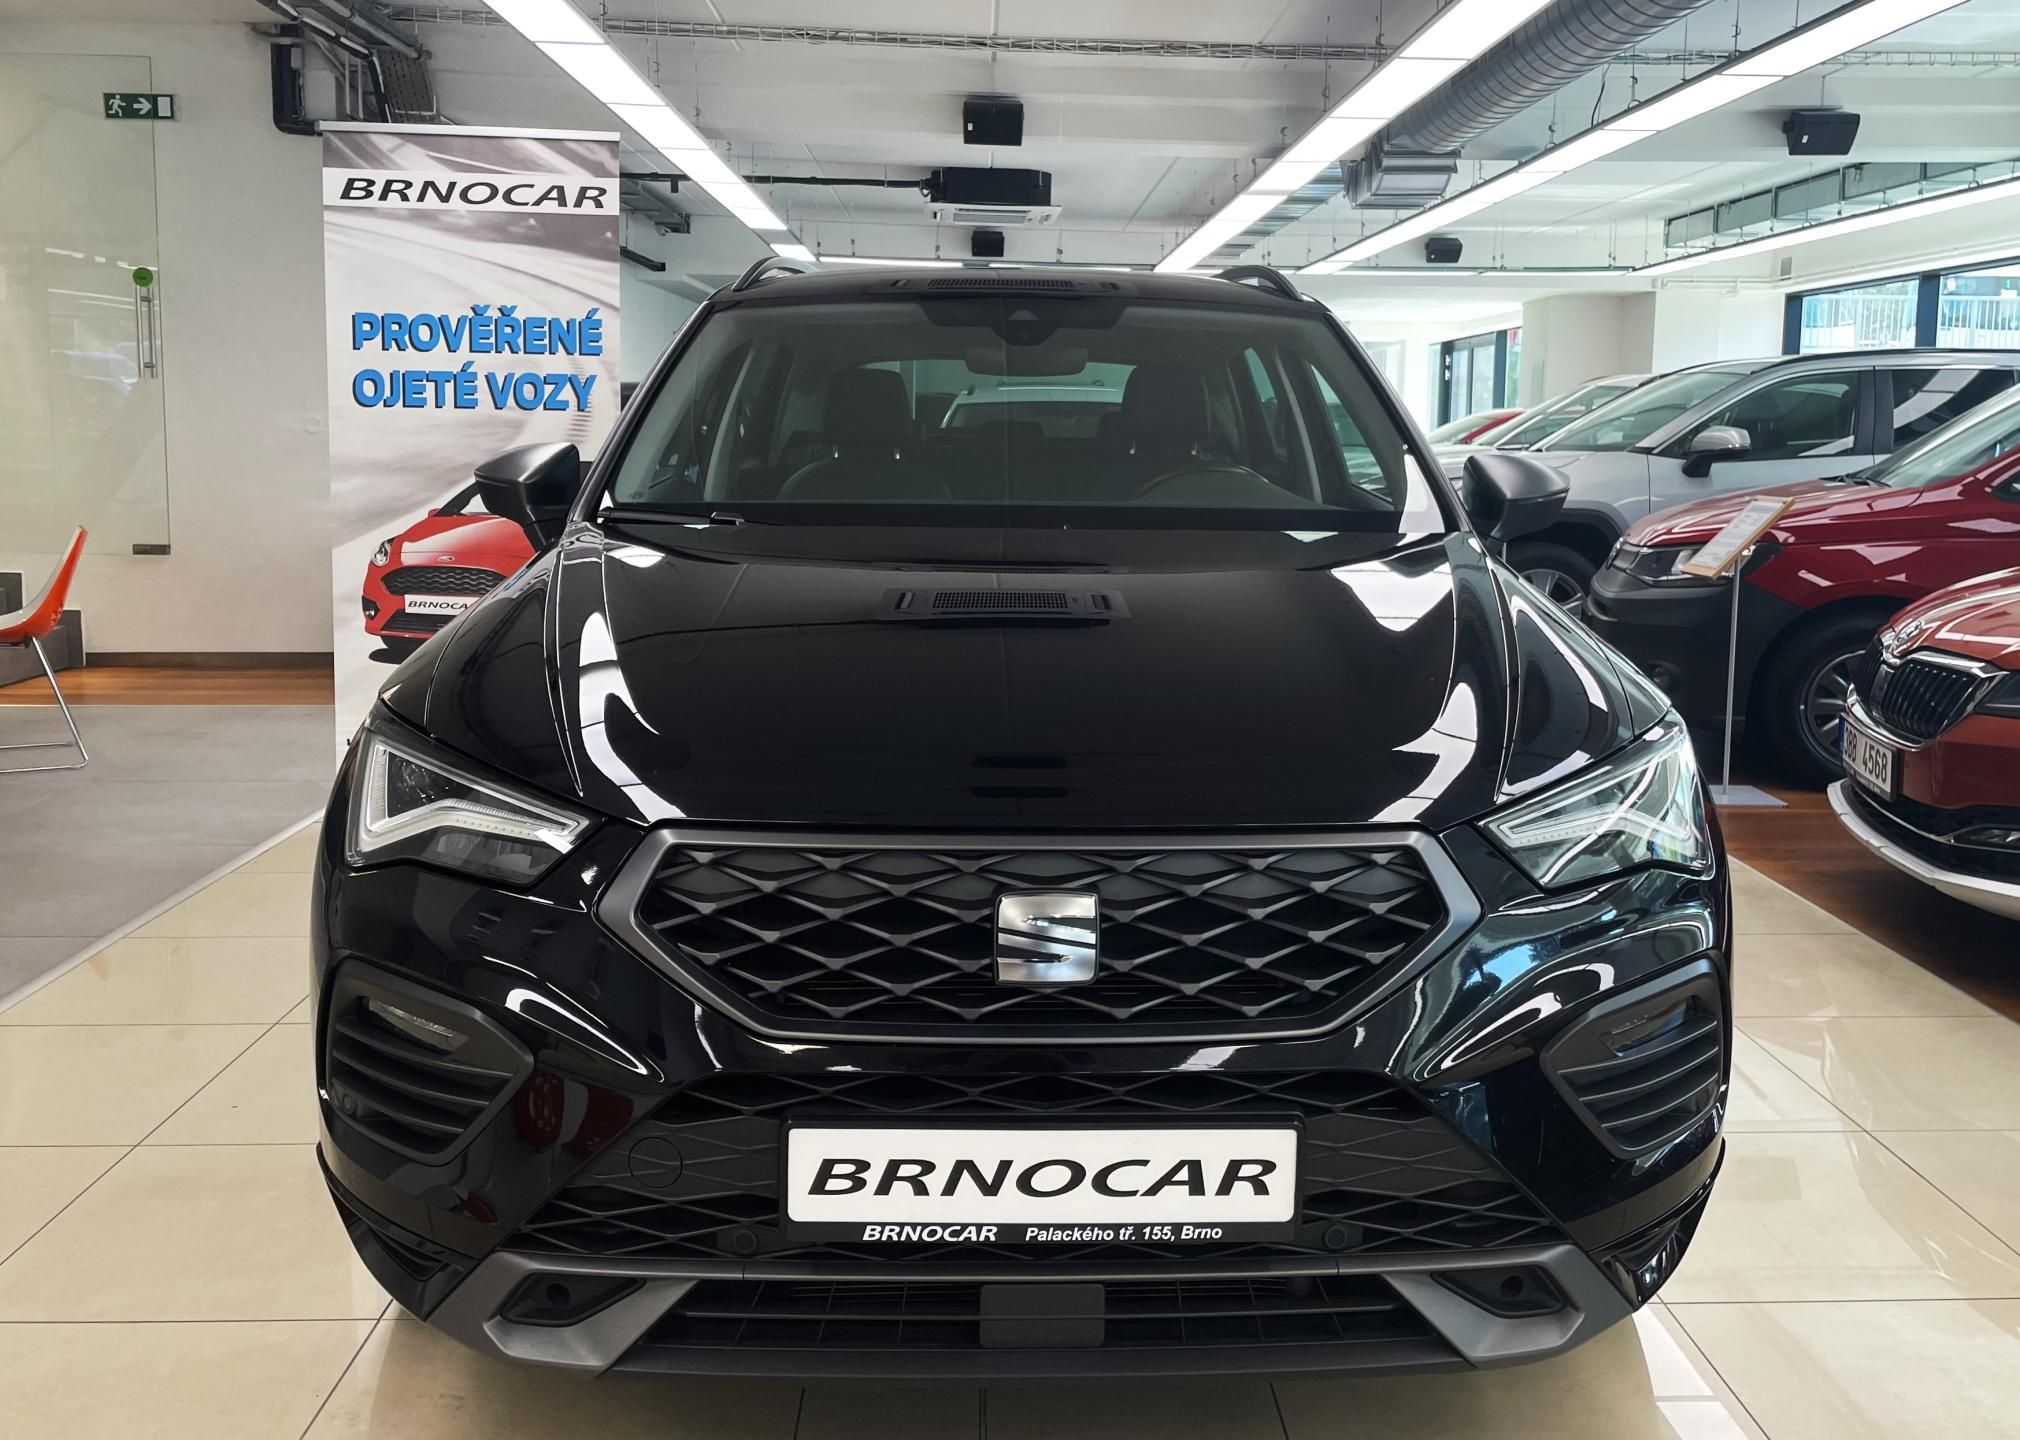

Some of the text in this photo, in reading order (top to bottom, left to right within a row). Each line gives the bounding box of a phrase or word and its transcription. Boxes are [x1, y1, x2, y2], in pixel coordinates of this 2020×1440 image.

[339, 177, 607, 209] BRNOCAR
[351, 304, 604, 356] PROVĚŘENÉ
[352, 361, 597, 411] OJETÉ VOZY
[408, 600, 468, 611] BRNOCA
[1862, 741, 1888, 784] 4568
[807, 1158, 1277, 1198] BRNOCAR
[862, 1225, 1223, 1242] BRNOCAR Palackého tř. 155, Brno
